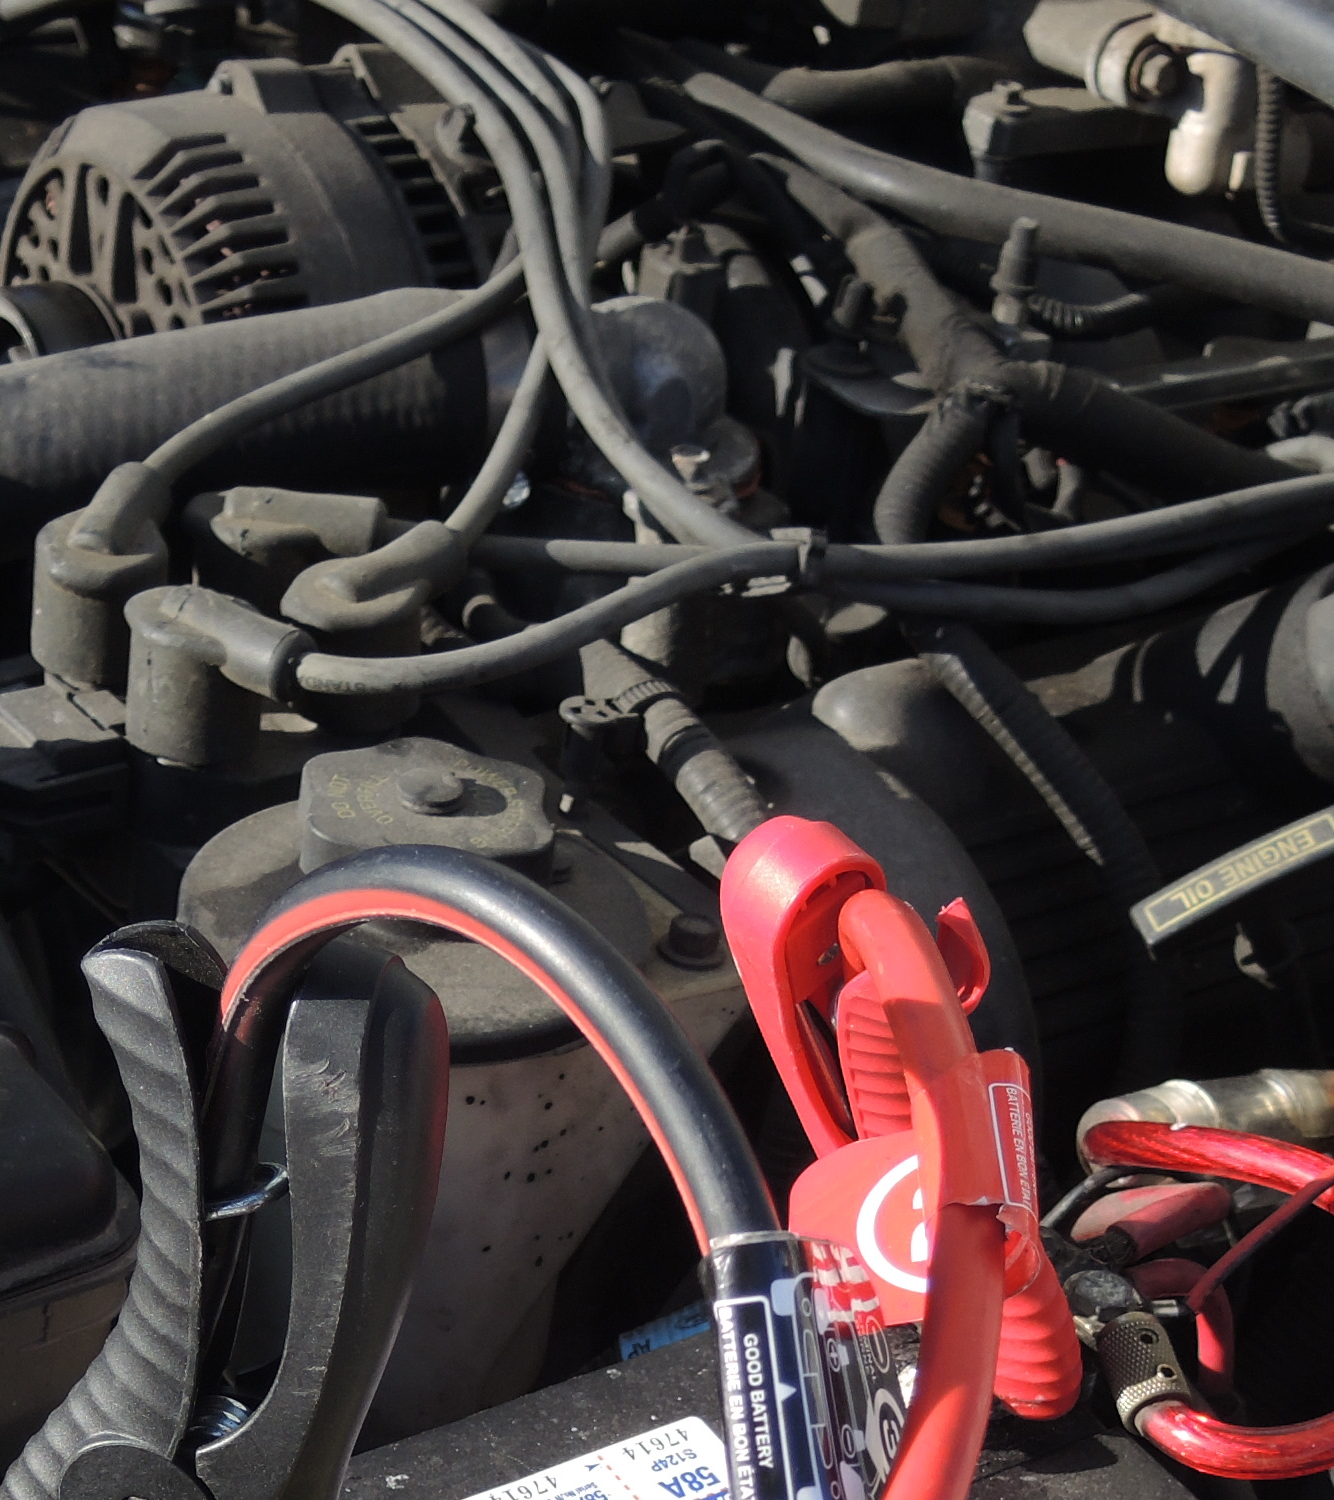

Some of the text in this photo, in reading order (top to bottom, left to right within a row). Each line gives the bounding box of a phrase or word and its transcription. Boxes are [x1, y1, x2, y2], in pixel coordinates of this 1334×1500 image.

[1169, 829, 1316, 911] ENGINE OIL
[1005, 1086, 1023, 1136] BATTERIE
[1016, 1151, 1028, 1177] BON
[718, 1306, 742, 1396] BATTERIE
[728, 1398, 745, 1421] EN
[743, 1333, 774, 1469] GOOD BATTERY
[618, 1425, 692, 1461] 47614
[646, 1446, 697, 1472] S124P
[731, 1423, 750, 1462] BON
[657, 1464, 721, 1500] 58A
